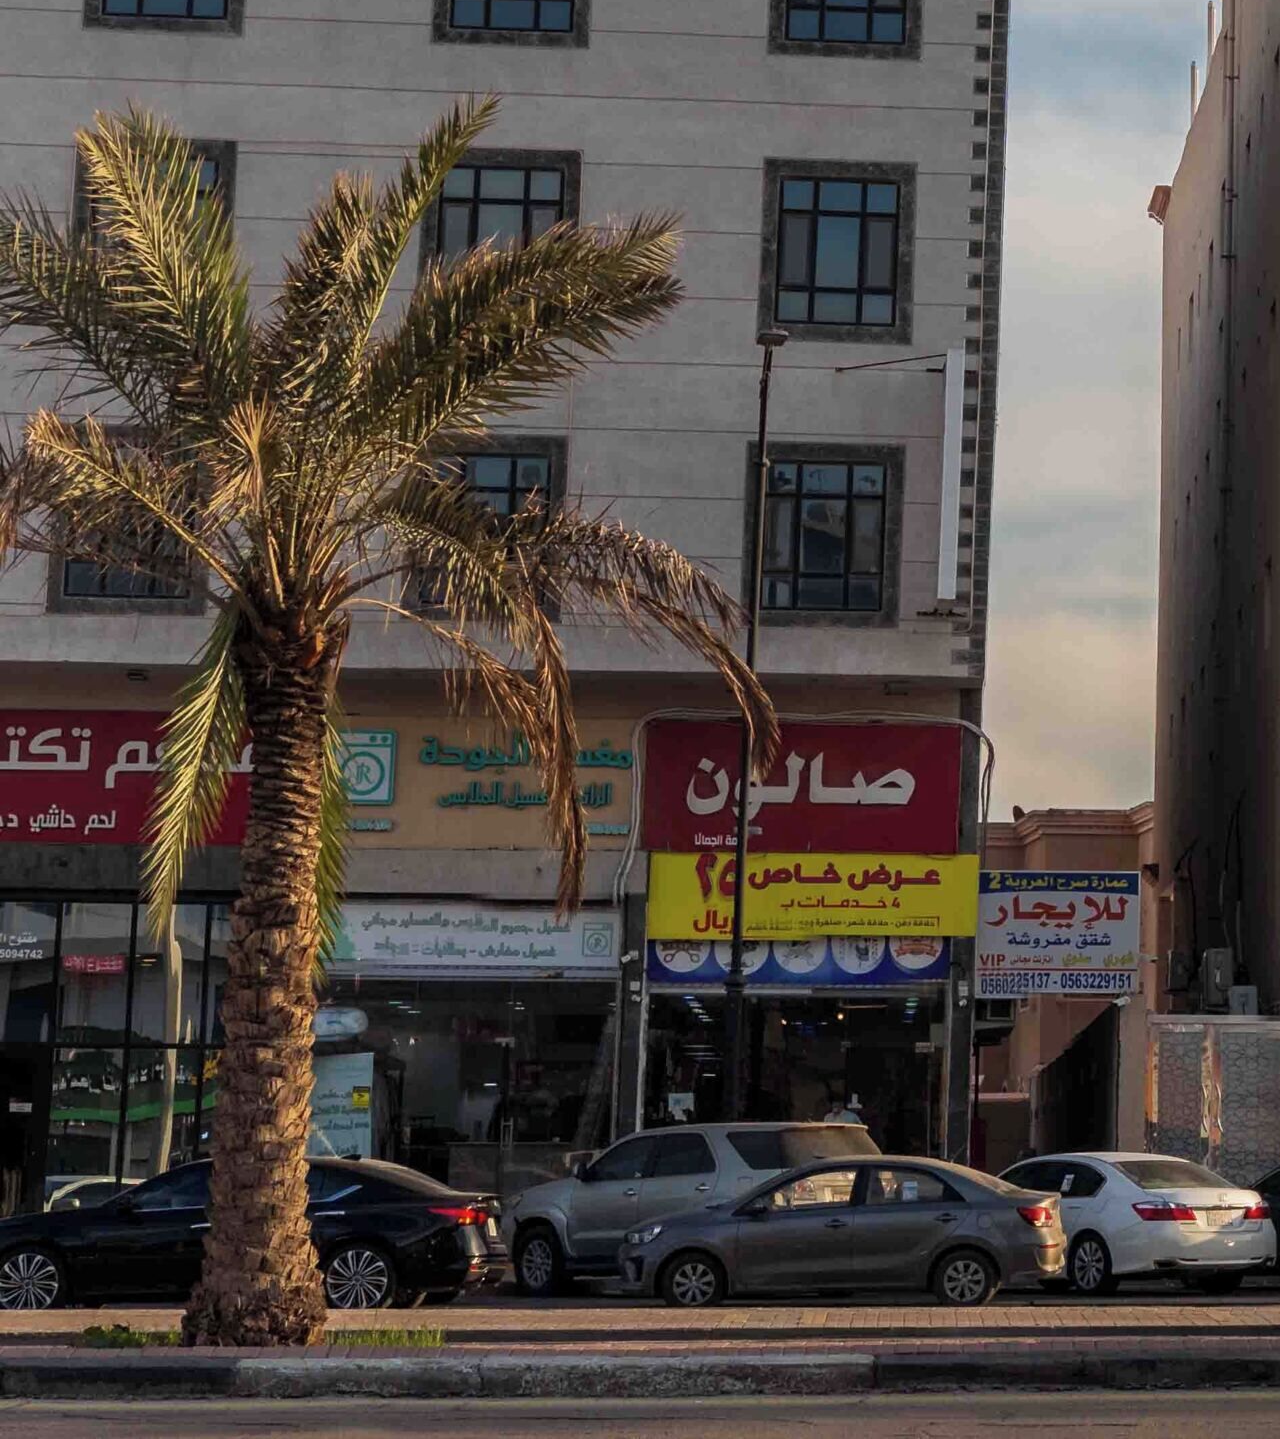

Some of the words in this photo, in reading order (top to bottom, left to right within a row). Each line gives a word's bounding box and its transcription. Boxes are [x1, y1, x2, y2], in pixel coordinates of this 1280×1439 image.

[686, 750, 917, 821] صالون
[29, 804, 76, 832] حاشي
[84, 809, 117, 835] لحم
[748, 862, 842, 890] خاص
[847, 862, 941, 891] عرض
[989, 872, 1000, 890] 2
[1056, 876, 1089, 890] صرح
[1091, 874, 1129, 890] عمارة
[796, 895, 887, 909] خدمات
[984, 894, 1130, 932] للإيجار
[1006, 932, 1071, 949] مفروشة
[1076, 932, 1111, 949] شقق
[0, 949, 43, 959] 5094742
[979, 953, 1006, 967] VIP
[1060, 972, 1132, 989] 0563229151
